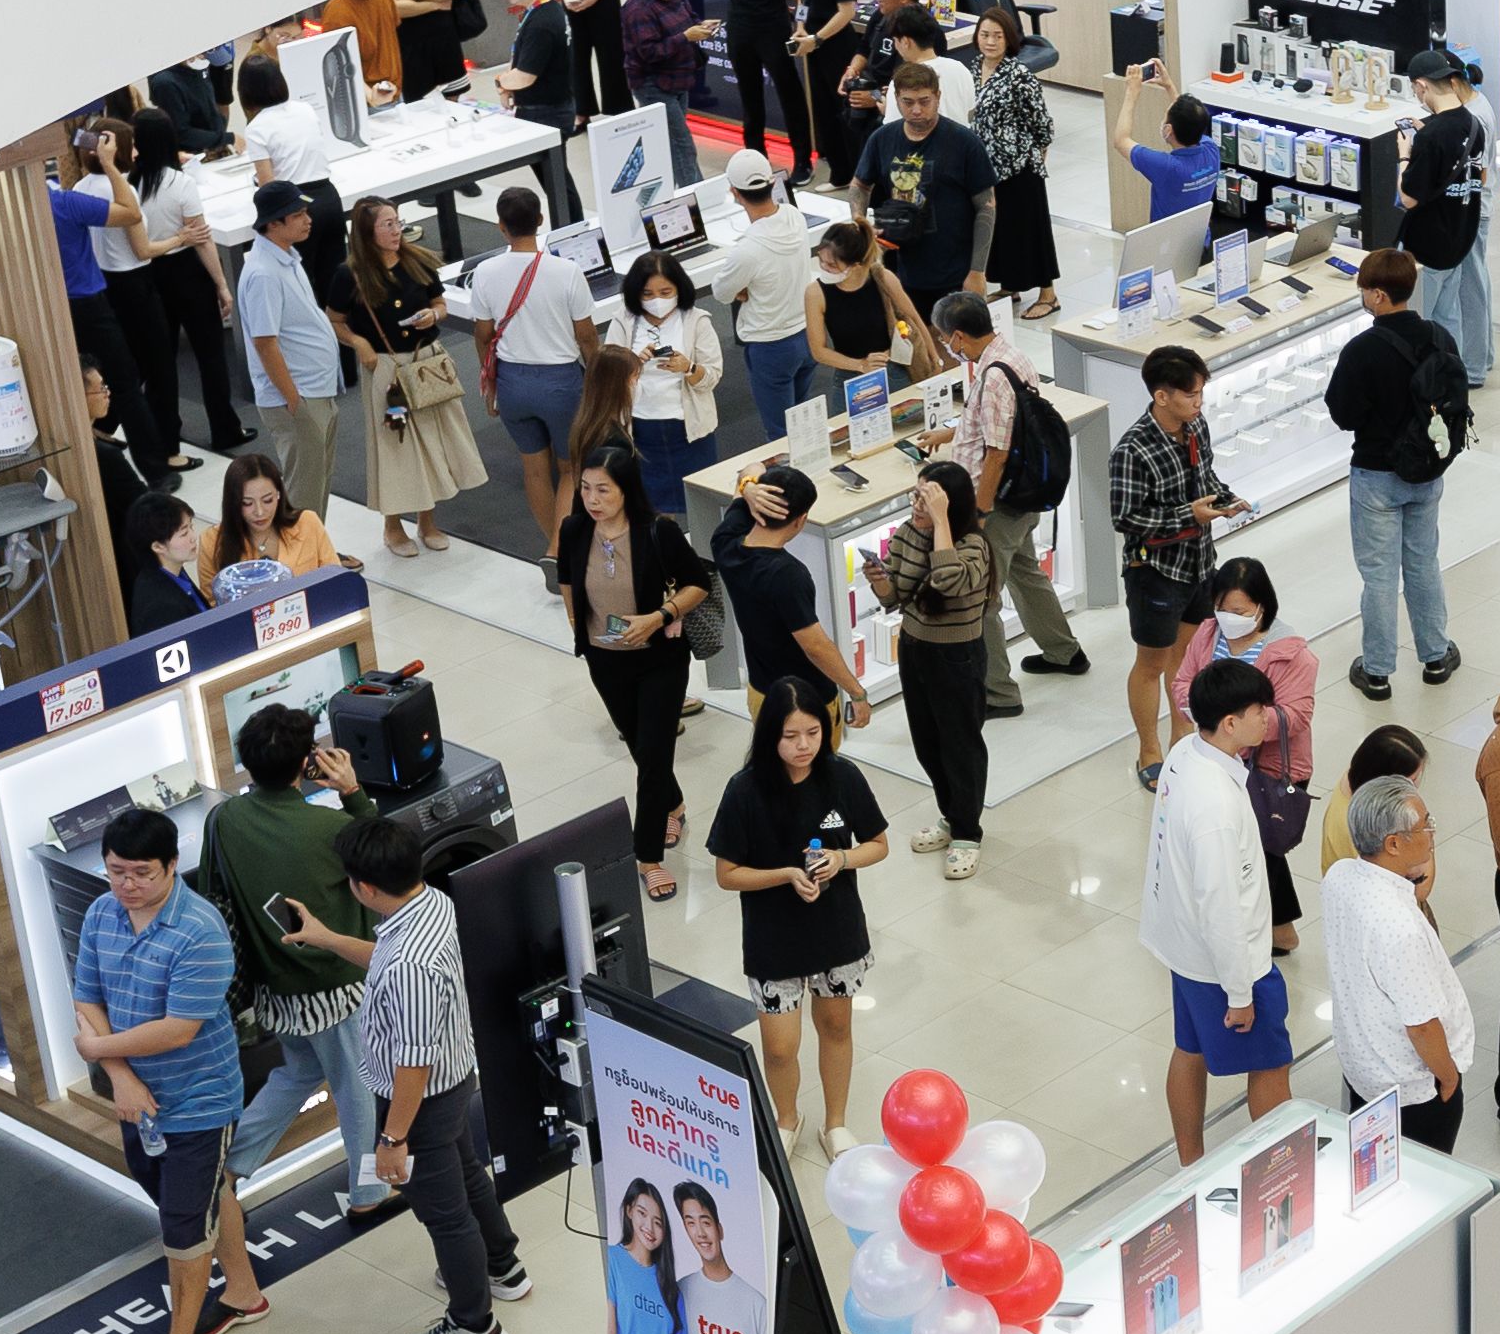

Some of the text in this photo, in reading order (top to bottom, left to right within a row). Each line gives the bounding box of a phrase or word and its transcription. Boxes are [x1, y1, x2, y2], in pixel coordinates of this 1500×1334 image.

[820, 820, 844, 830] adidas
[604, 1065, 741, 1137] ทรูช็อปพร้อมให้บริการ
[697, 1073, 741, 1110] true
[631, 1098, 720, 1162] ลูกค้าทรู
[627, 1125, 730, 1188] และดีแทค
[633, 1292, 665, 1320] dtac
